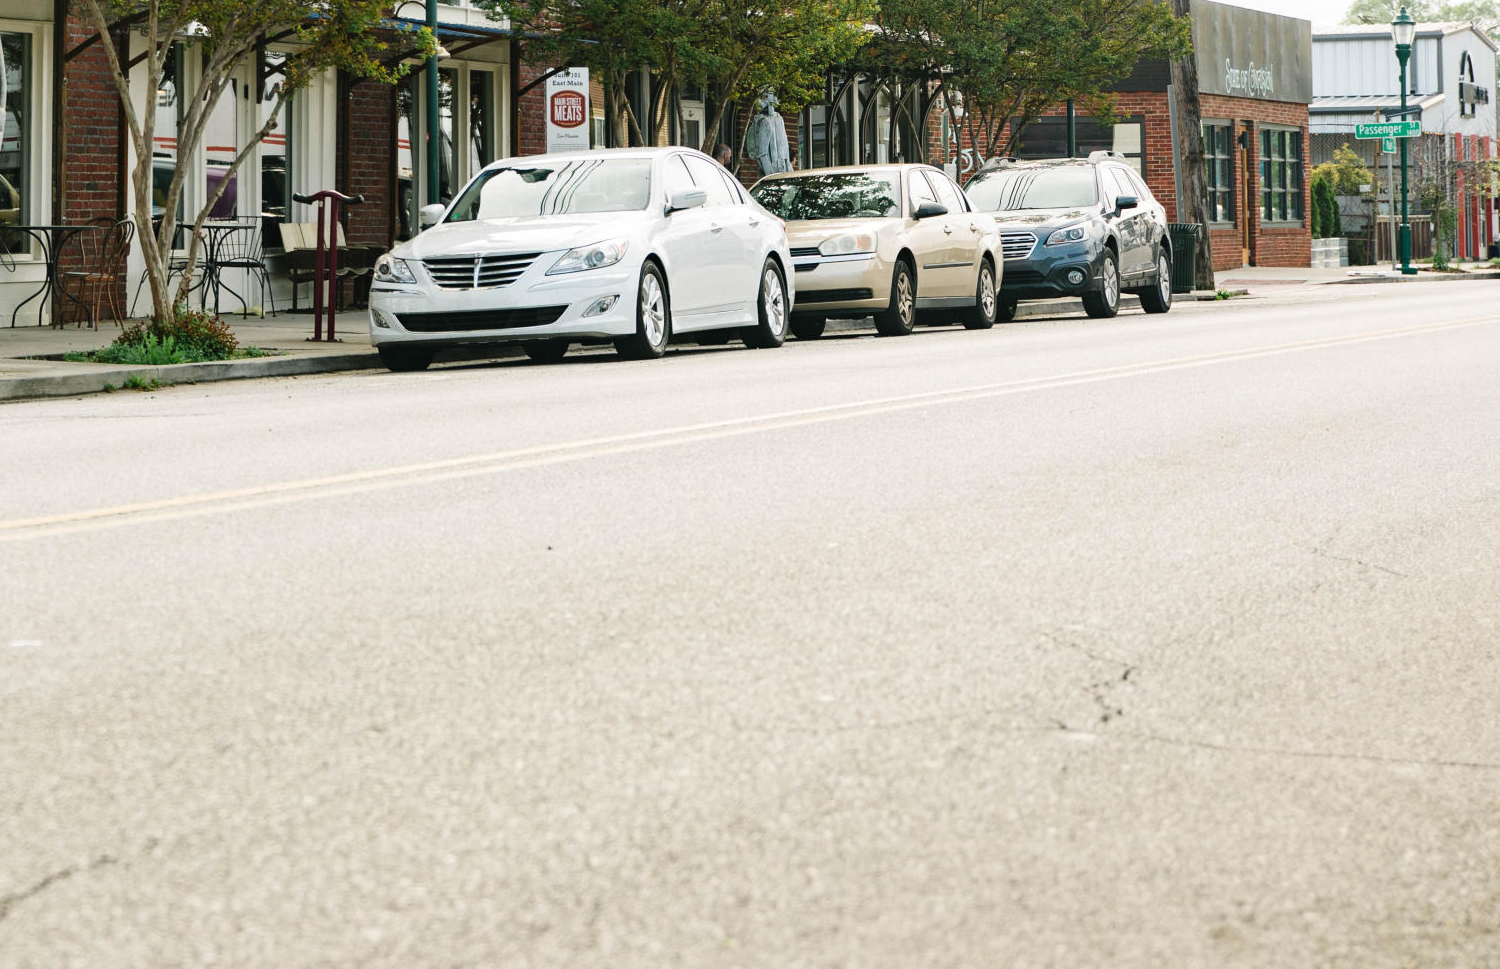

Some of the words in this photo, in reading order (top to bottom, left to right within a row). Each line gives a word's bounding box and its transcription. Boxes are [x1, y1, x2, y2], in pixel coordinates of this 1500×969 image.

[554, 97, 566, 105] MAIN
[566, 97, 581, 105] STREET
[554, 105, 582, 121] MEATS
[1358, 124, 1402, 136] Passenger
